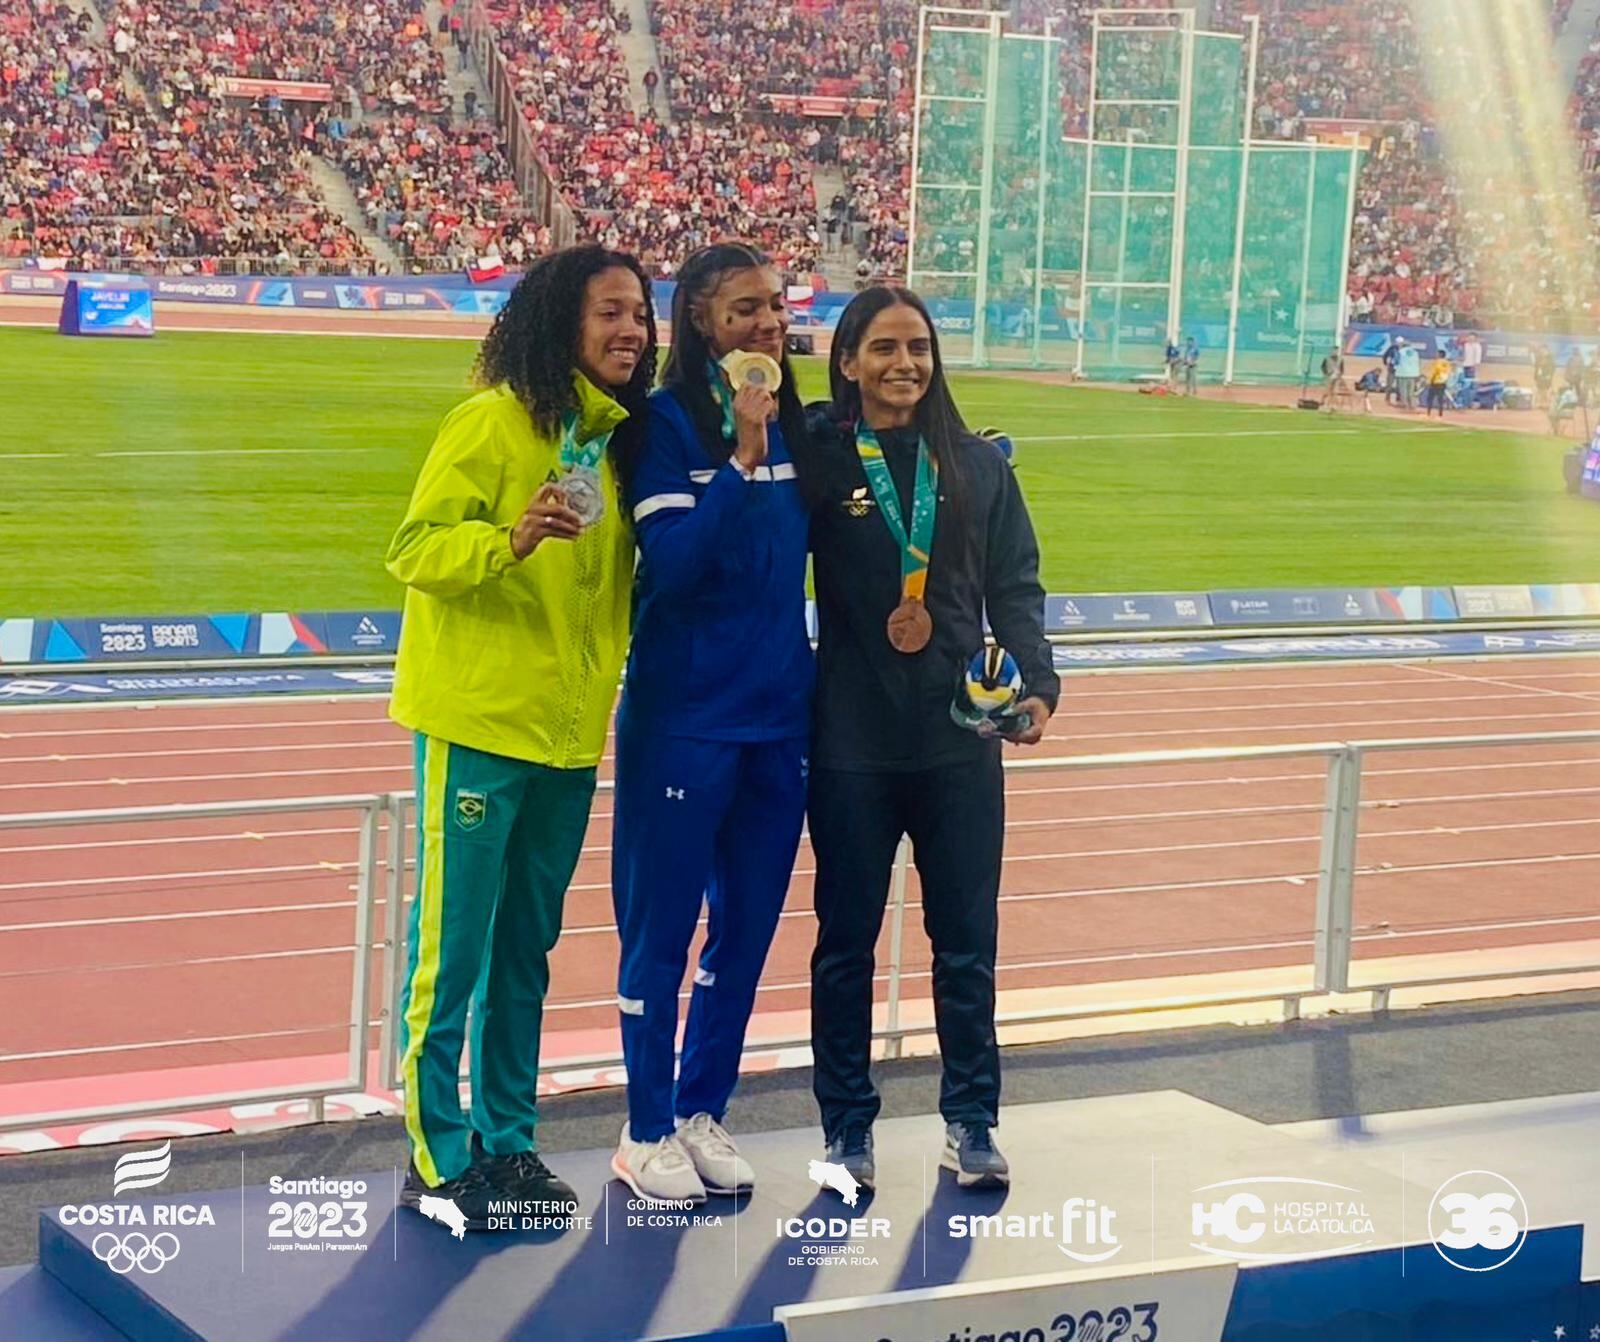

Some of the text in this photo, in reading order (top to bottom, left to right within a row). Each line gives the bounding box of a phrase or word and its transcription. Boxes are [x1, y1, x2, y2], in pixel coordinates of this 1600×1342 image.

[204, 284, 237, 298] 2023
[102, 634, 147, 652] 2023
[153, 635, 199, 648] SPORTS
